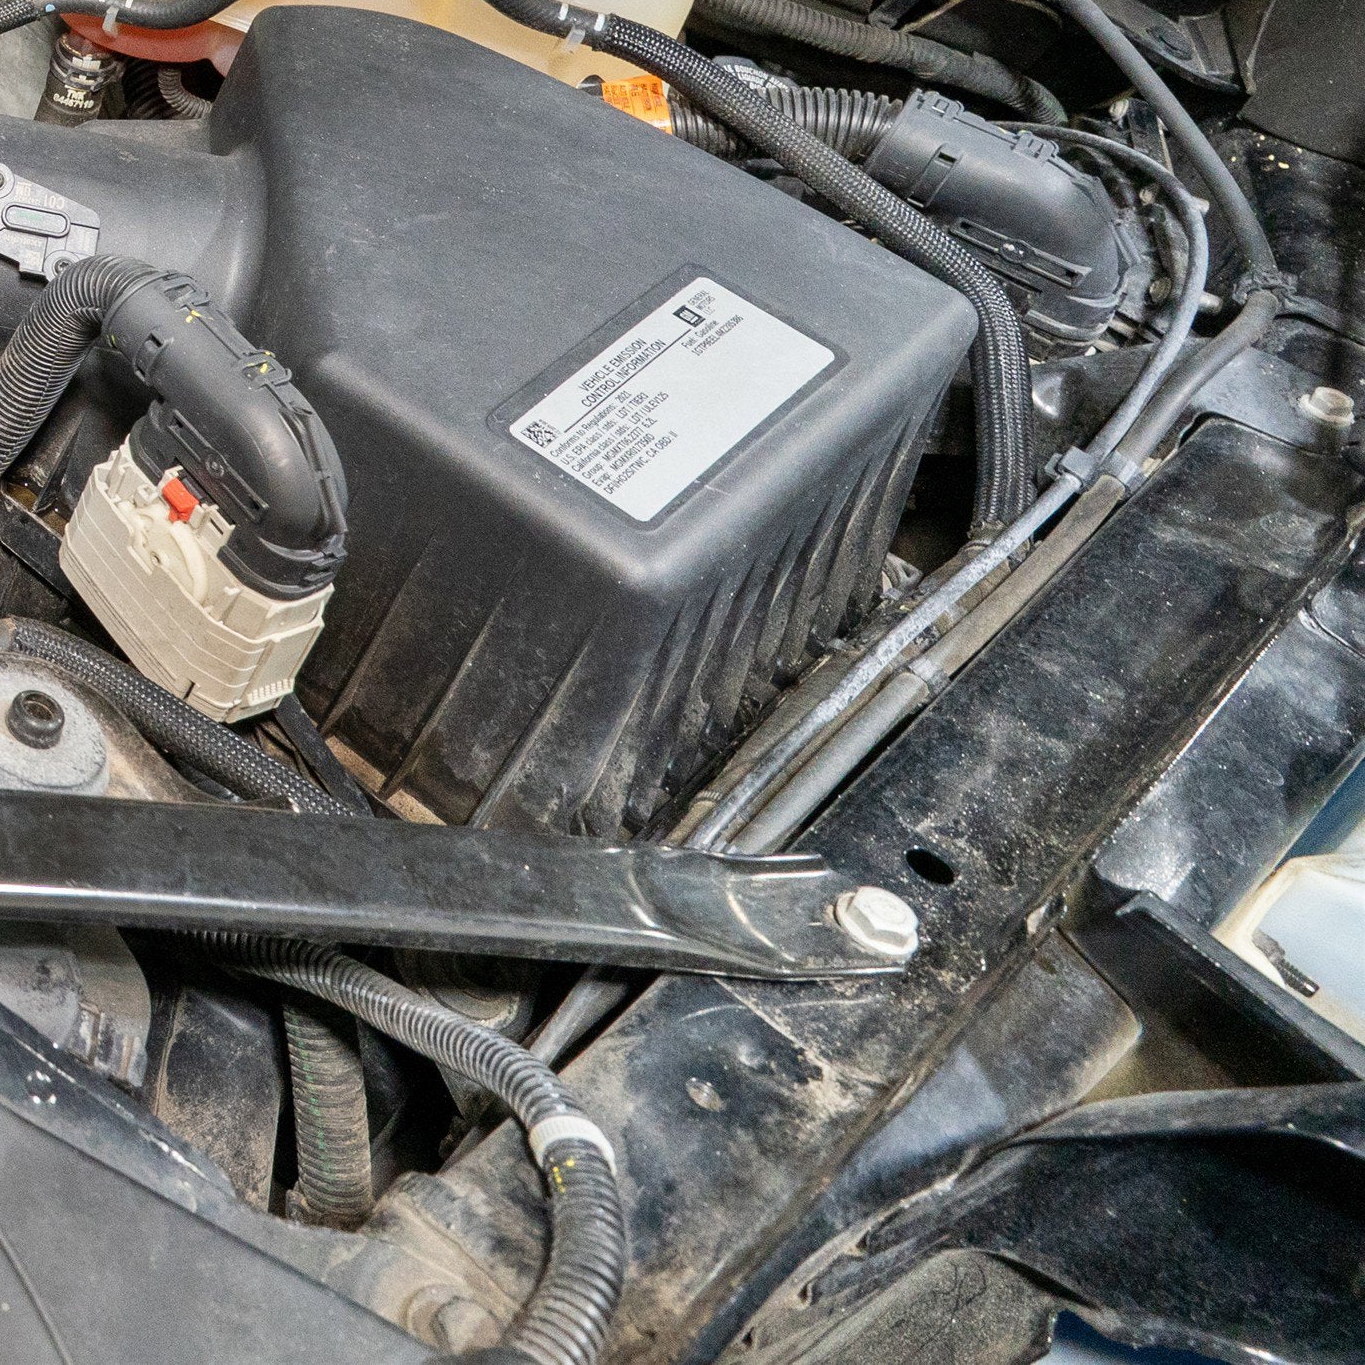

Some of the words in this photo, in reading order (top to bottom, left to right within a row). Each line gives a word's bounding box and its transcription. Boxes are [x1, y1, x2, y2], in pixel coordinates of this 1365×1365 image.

[579, 364, 615, 392] VEHICLE
[608, 338, 647, 368] EMISSION
[580, 379, 621, 408] CONTROL
[616, 339, 667, 377] INFORMATION
[549, 434, 581, 458] Conforms
[615, 390, 632, 403] 2021
[570, 448, 602, 473] California
[598, 437, 615, 451] class
[628, 412, 643, 425] LDT
[571, 443, 587, 456] EPA
[585, 432, 602, 446] class
[615, 406, 630, 419] LDT
